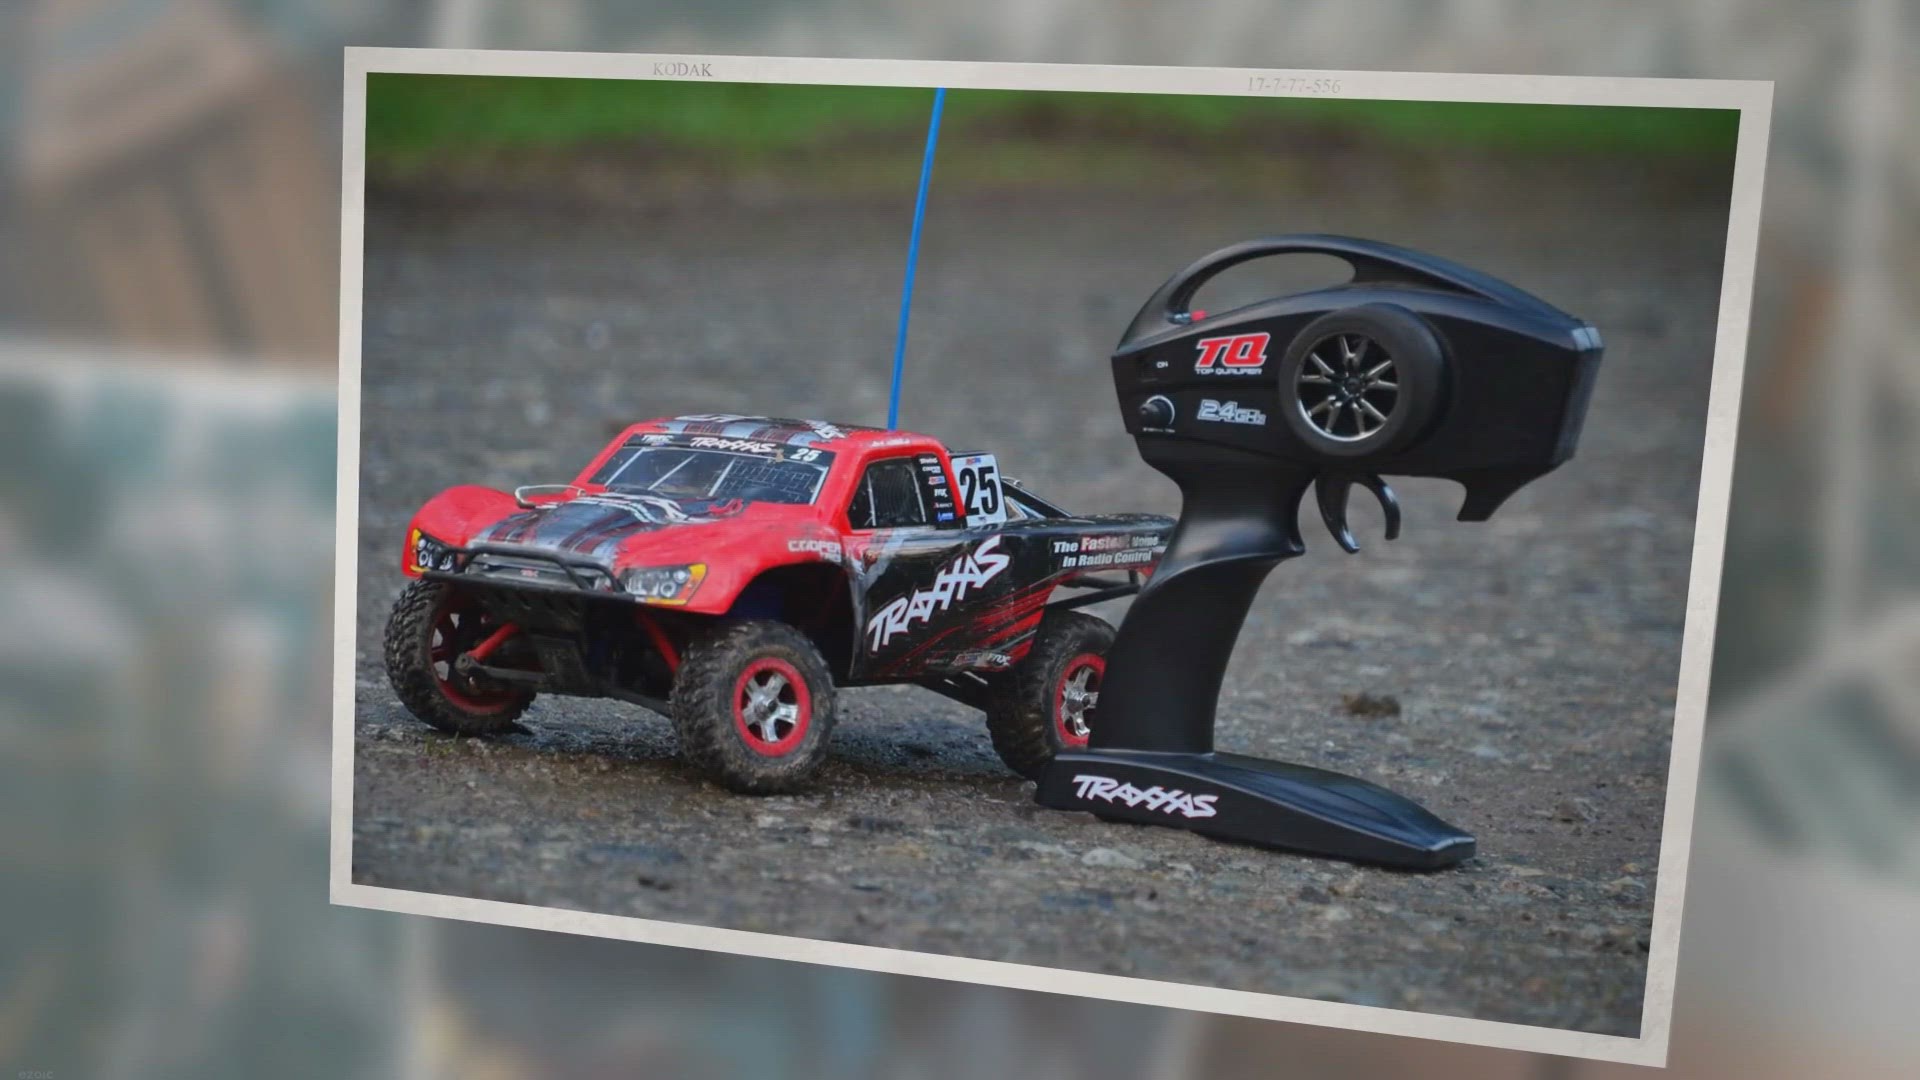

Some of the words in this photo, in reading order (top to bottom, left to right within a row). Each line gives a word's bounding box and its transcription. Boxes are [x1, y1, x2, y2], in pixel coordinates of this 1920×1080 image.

[653, 62, 713, 77] KODAK
[1195, 332, 1270, 368] TQ
[690, 436, 777, 453] TRAXXAS
[790, 448, 822, 462] 25
[959, 466, 999, 515] 25
[1053, 541, 1079, 553] The
[1062, 556, 1076, 567] In
[1078, 553, 1113, 566] Radio
[1114, 550, 1152, 563] Control
[867, 534, 1010, 652] TRAXXAS
[1072, 775, 1219, 818] TRAXXAS
